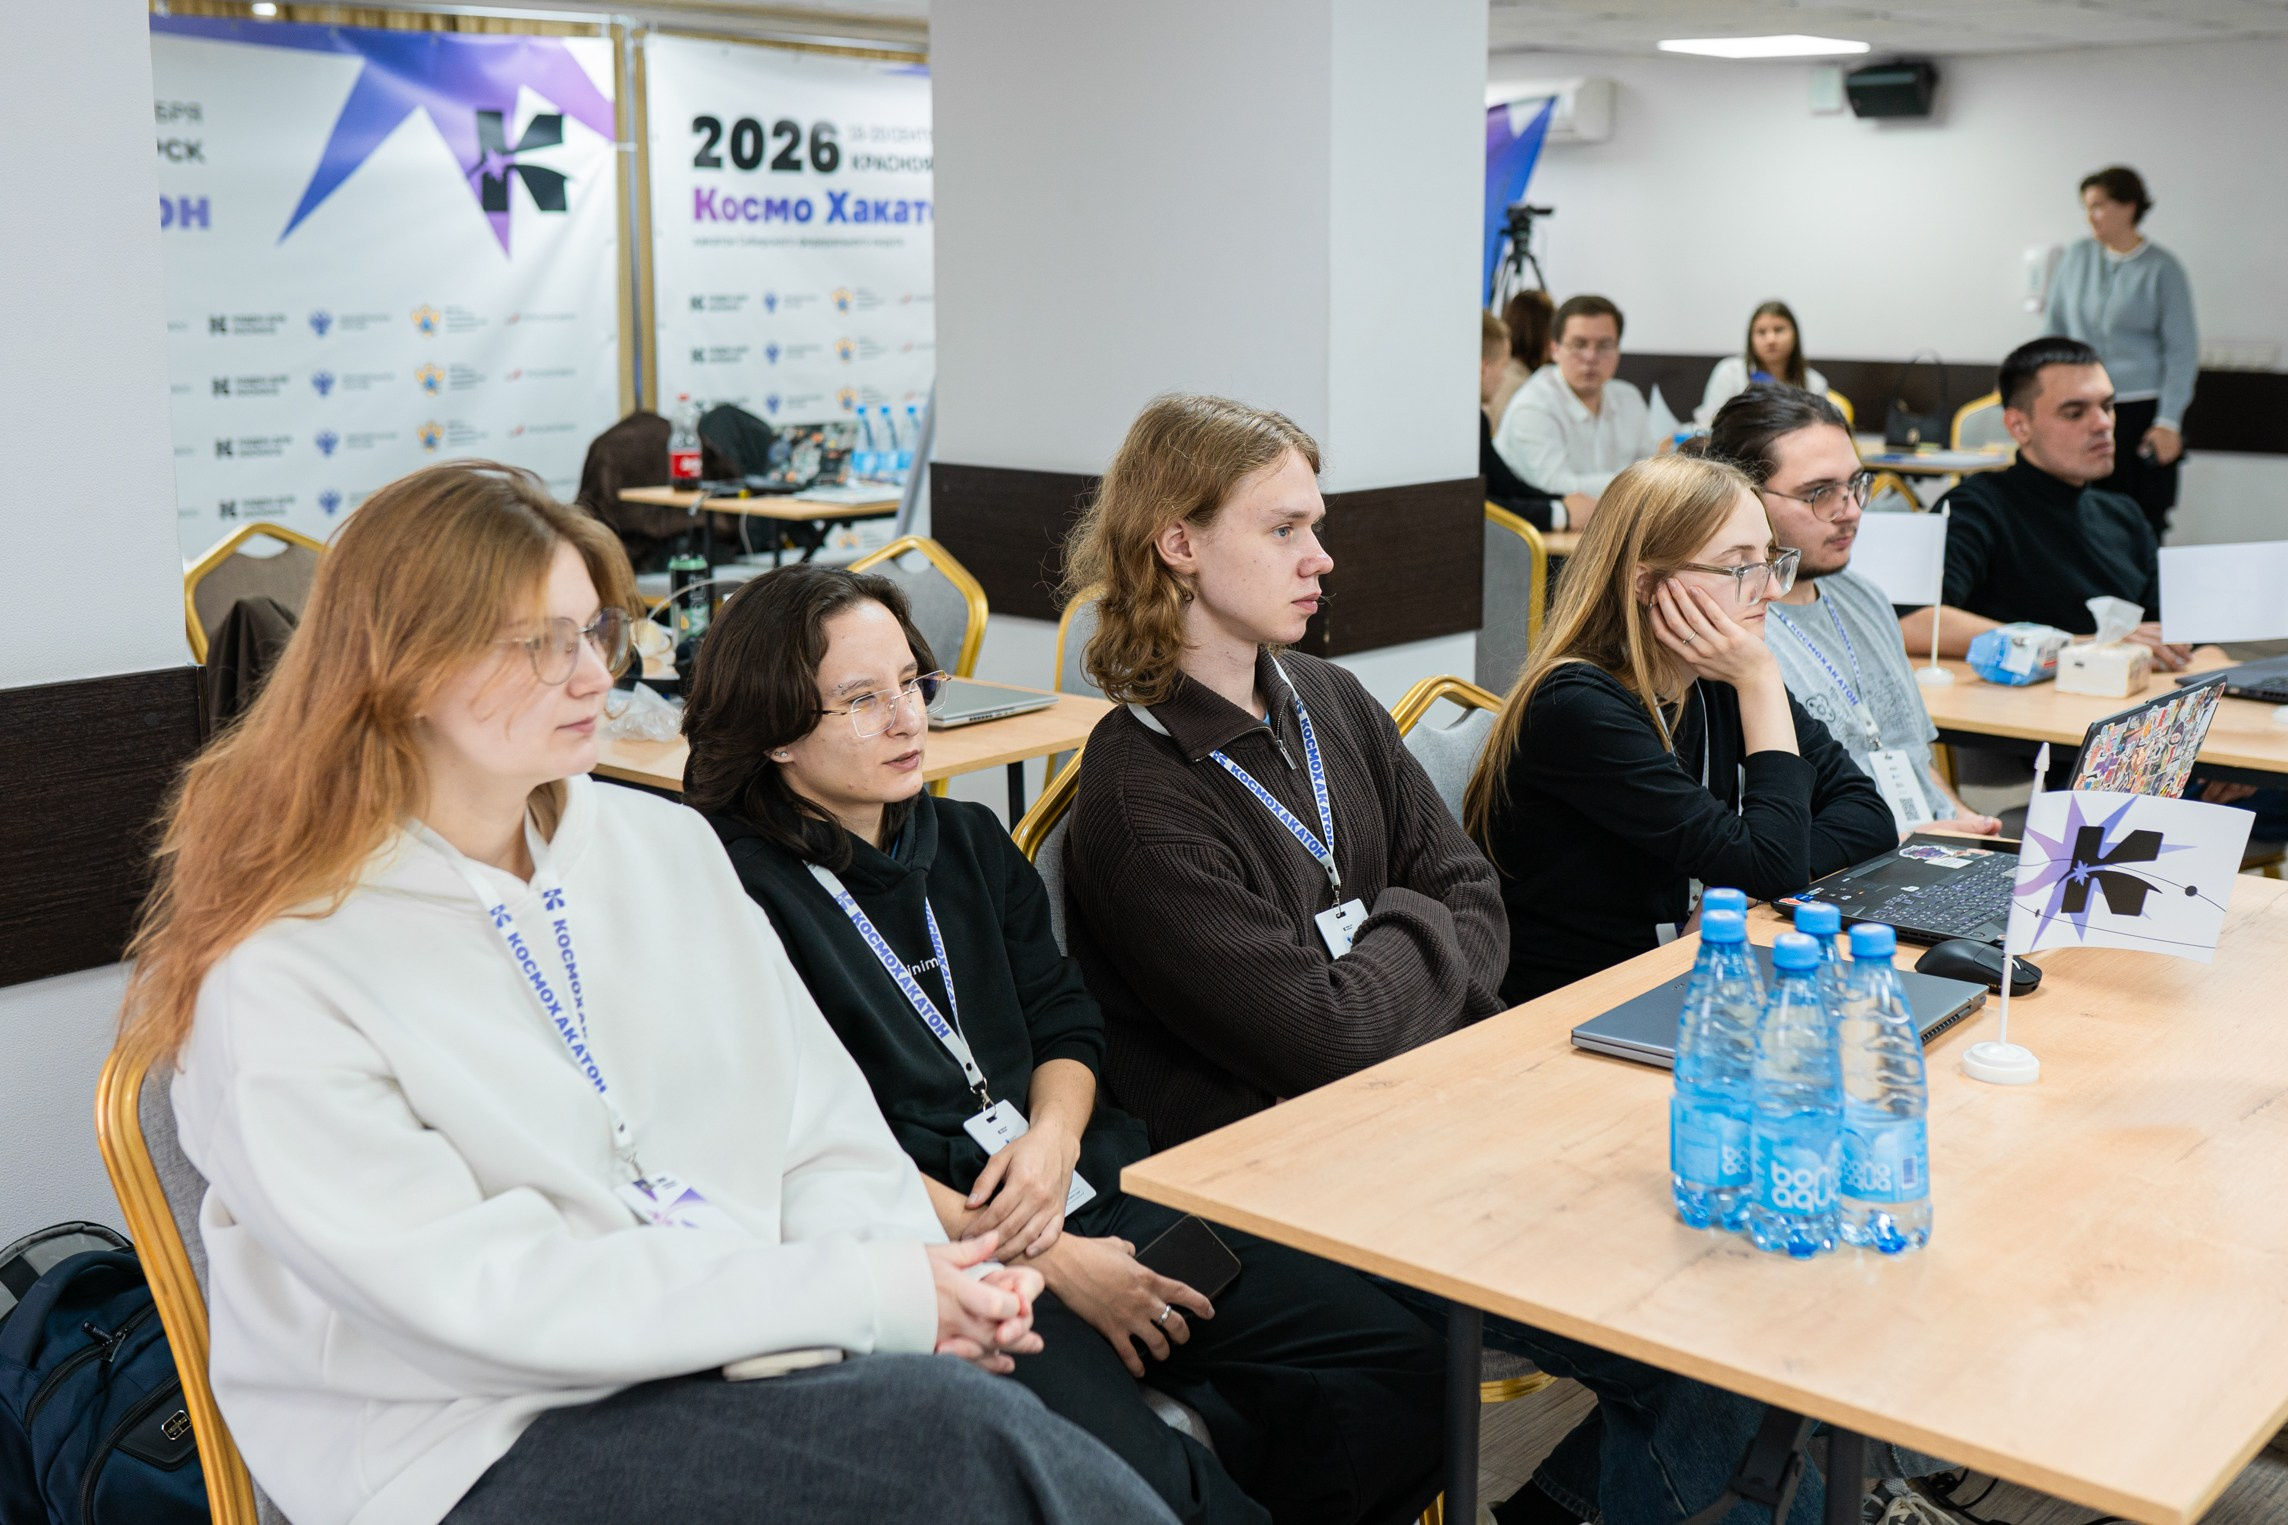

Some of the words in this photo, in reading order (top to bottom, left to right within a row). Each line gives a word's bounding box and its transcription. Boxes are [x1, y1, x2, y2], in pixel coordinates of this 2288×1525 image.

[157, 138, 206, 163] СК
[692, 115, 841, 174] 2026
[693, 187, 814, 225] Космо
[826, 190, 934, 225] Хакат
[1230, 764, 1328, 860] КОСМОХАКАТОН
[1300, 717, 1334, 846] КОСМОХАКАТОН
[507, 931, 608, 1094] КОСМОХАКАТОН
[850, 911, 950, 1039] КОСМОХАКАТОН
